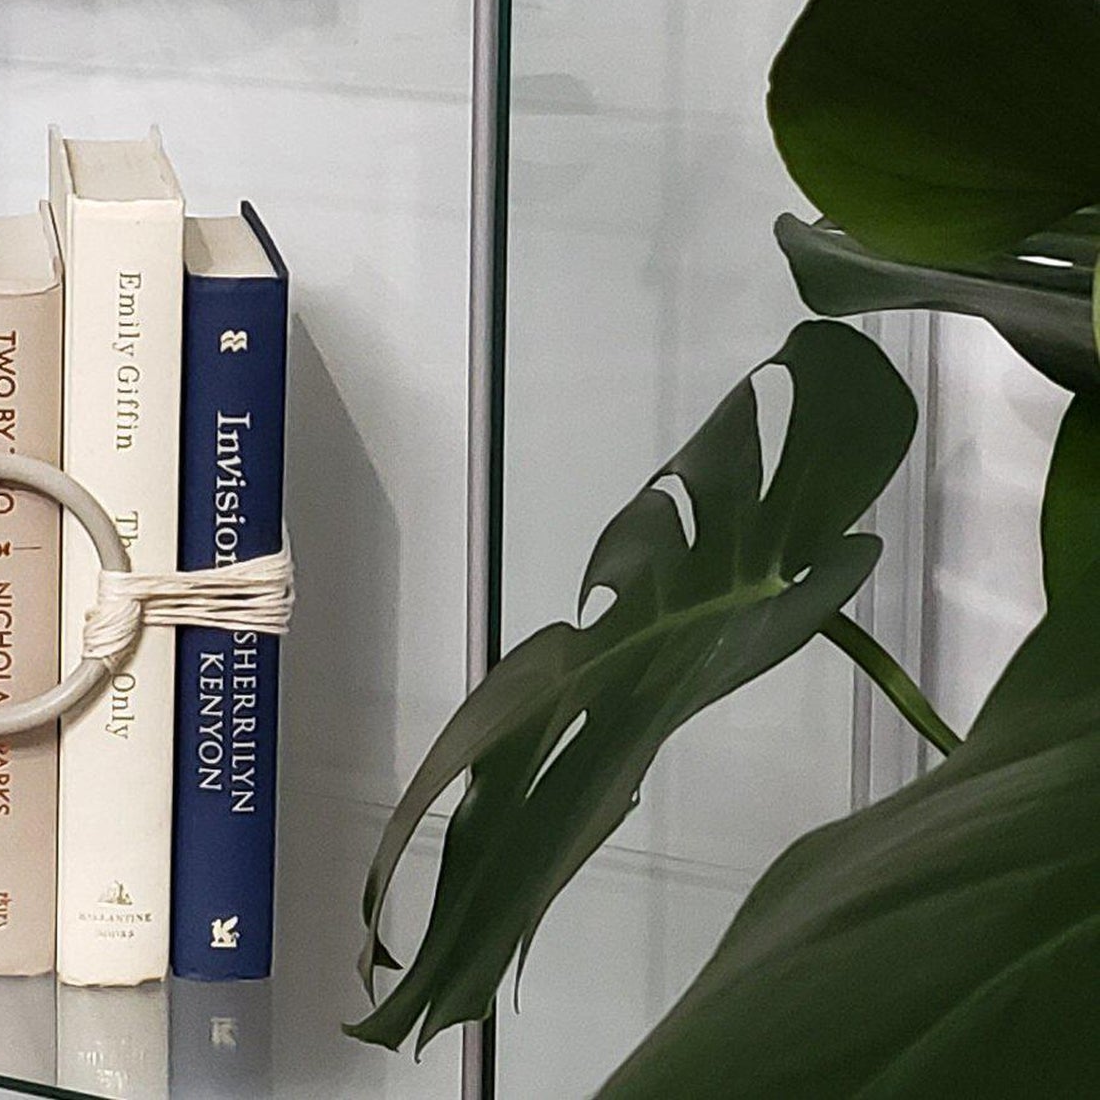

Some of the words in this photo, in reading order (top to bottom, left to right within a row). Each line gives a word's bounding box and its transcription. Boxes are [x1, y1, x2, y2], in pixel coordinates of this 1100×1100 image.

[112, 271, 142, 357] Emily
[116, 365, 140, 451] Giffin
[114, 510, 139, 550] Th
[104, 672, 136, 740] Only
[198, 652, 224, 791] KENYON
[231, 630, 258, 813] SHERRILYN
